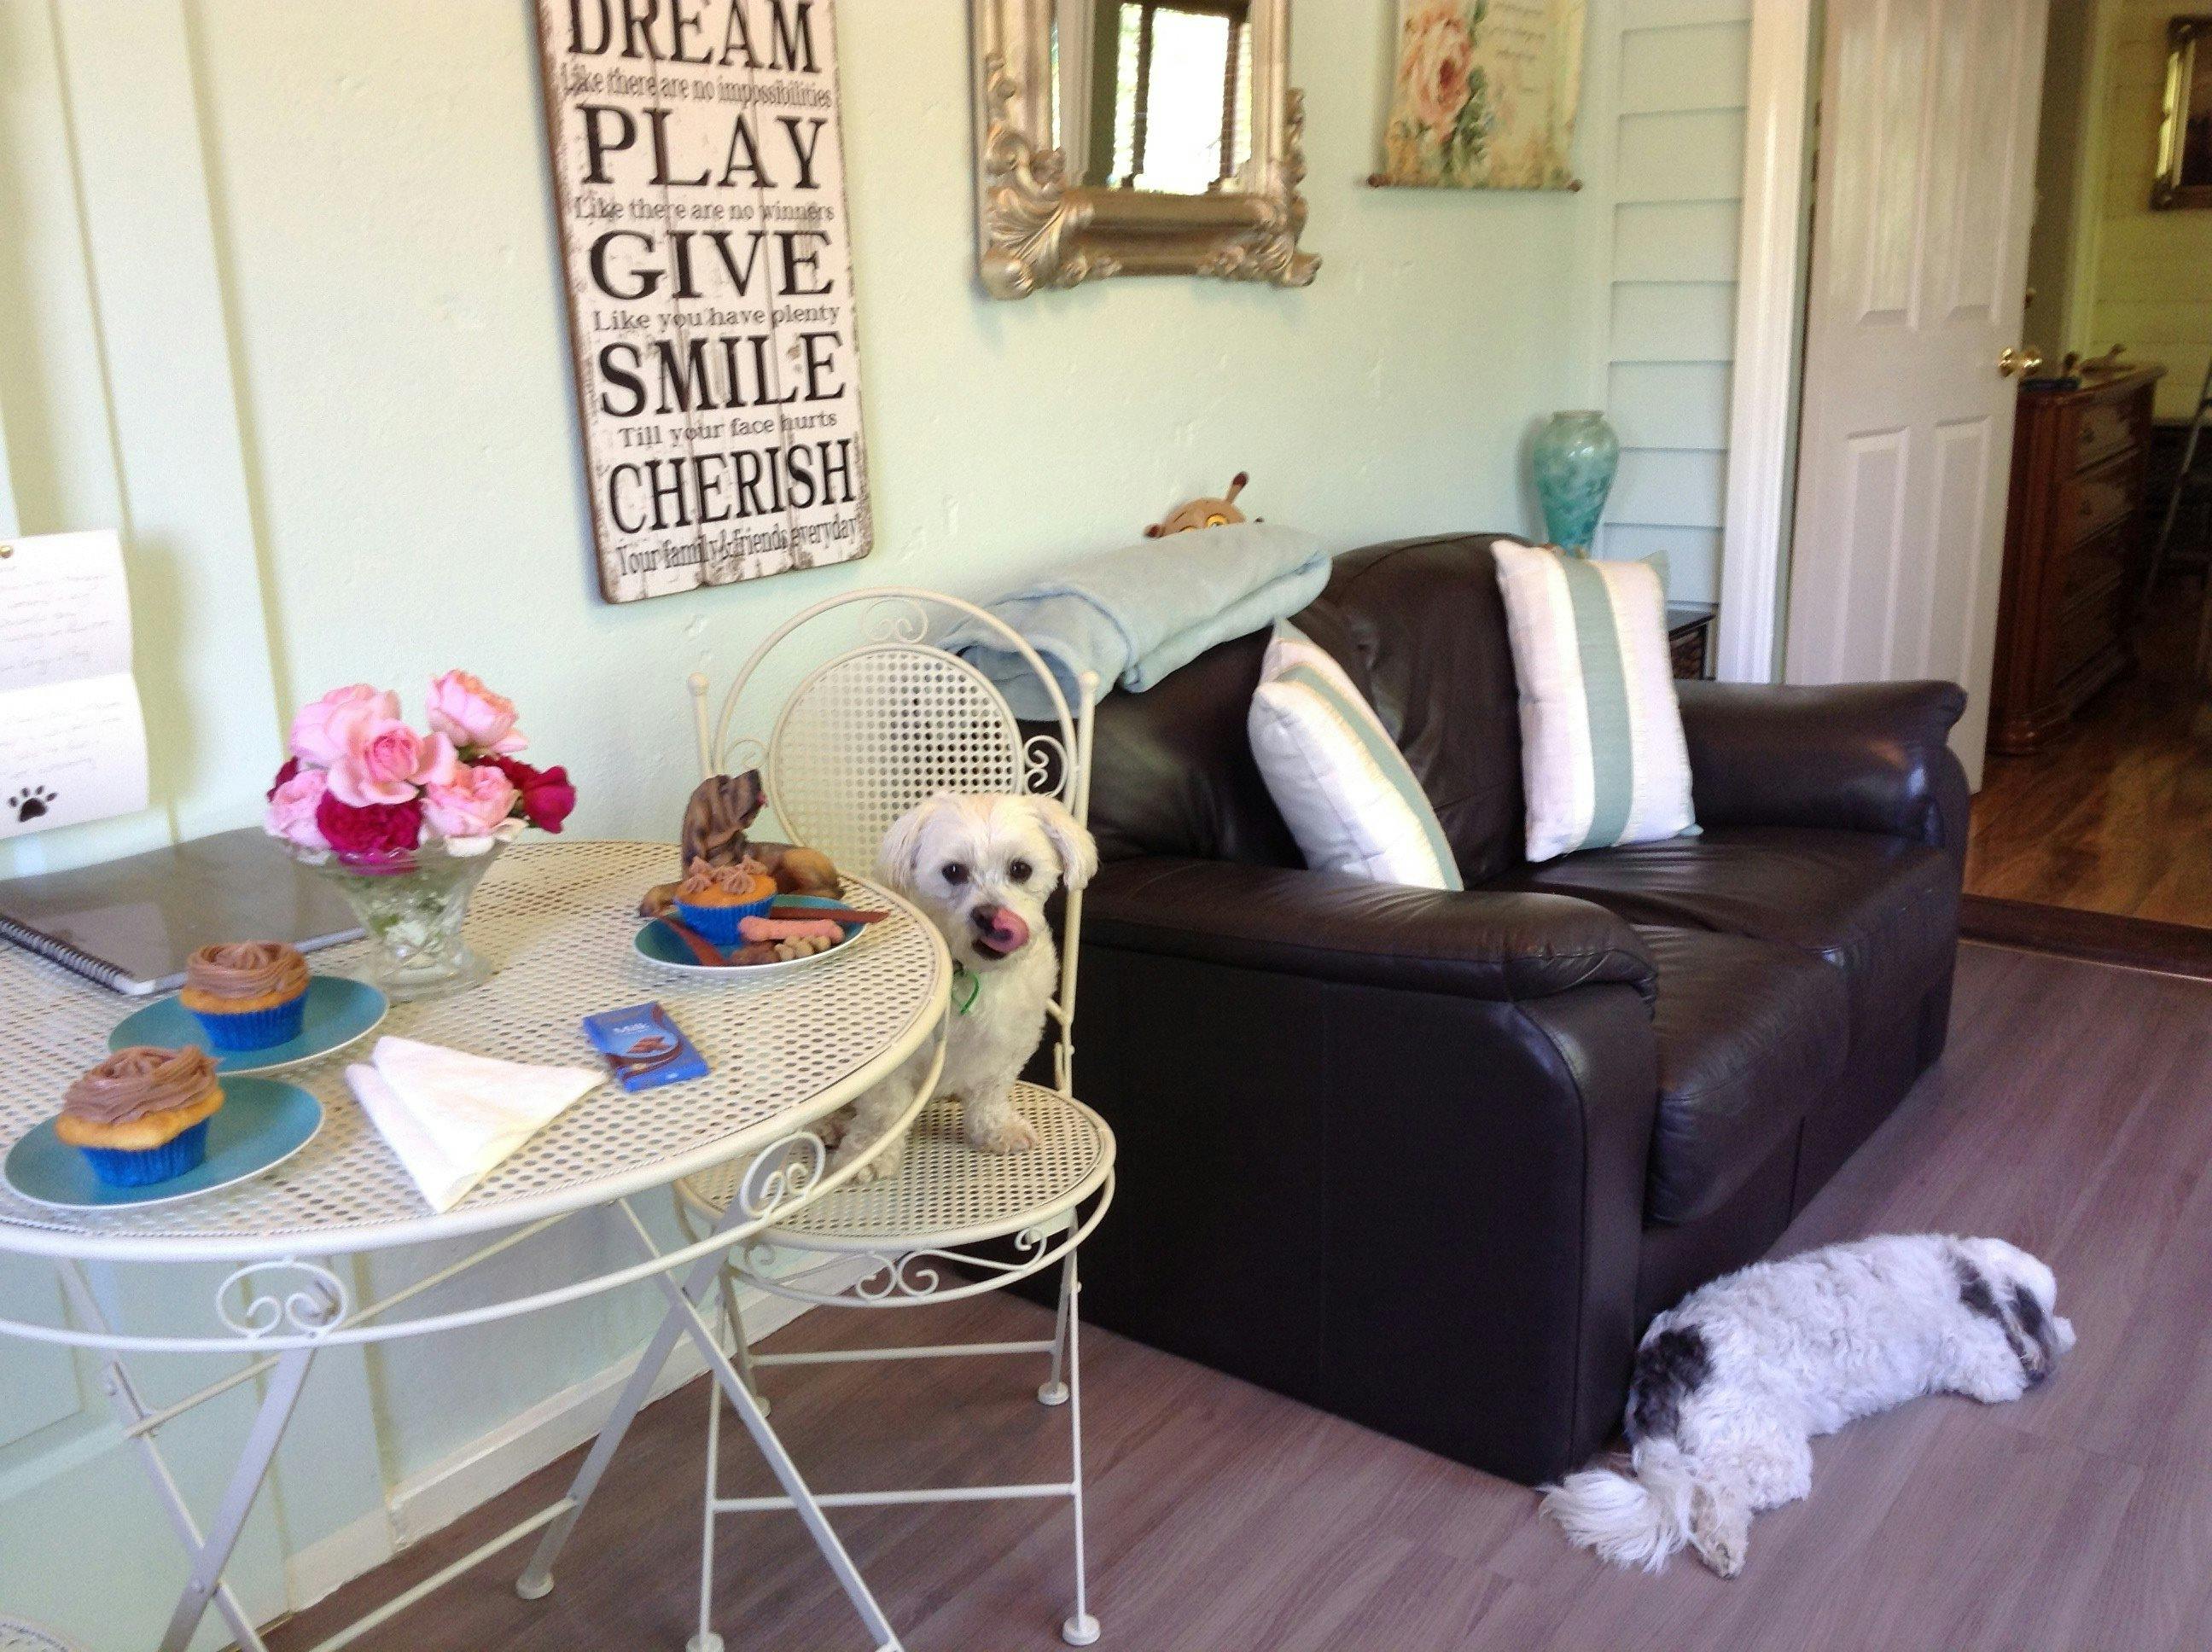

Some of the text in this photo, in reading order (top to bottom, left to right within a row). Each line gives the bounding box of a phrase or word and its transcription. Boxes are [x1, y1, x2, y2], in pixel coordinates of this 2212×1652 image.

[568, 0, 822, 73] DREAM
[607, 67, 657, 96] there
[661, 78, 690, 98] are
[692, 79, 714, 100] no
[717, 75, 832, 108] impossibilities
[575, 103, 828, 189] PLAY
[573, 195, 835, 221] Like there are no winners
[589, 229, 835, 300] GIVE
[593, 304, 841, 332] Like you have plenty
[598, 331, 846, 418] SMILE
[618, 410, 838, 448] Till your face hurts
[608, 437, 855, 534] CHERISH
[790, 513, 856, 550] everyday
